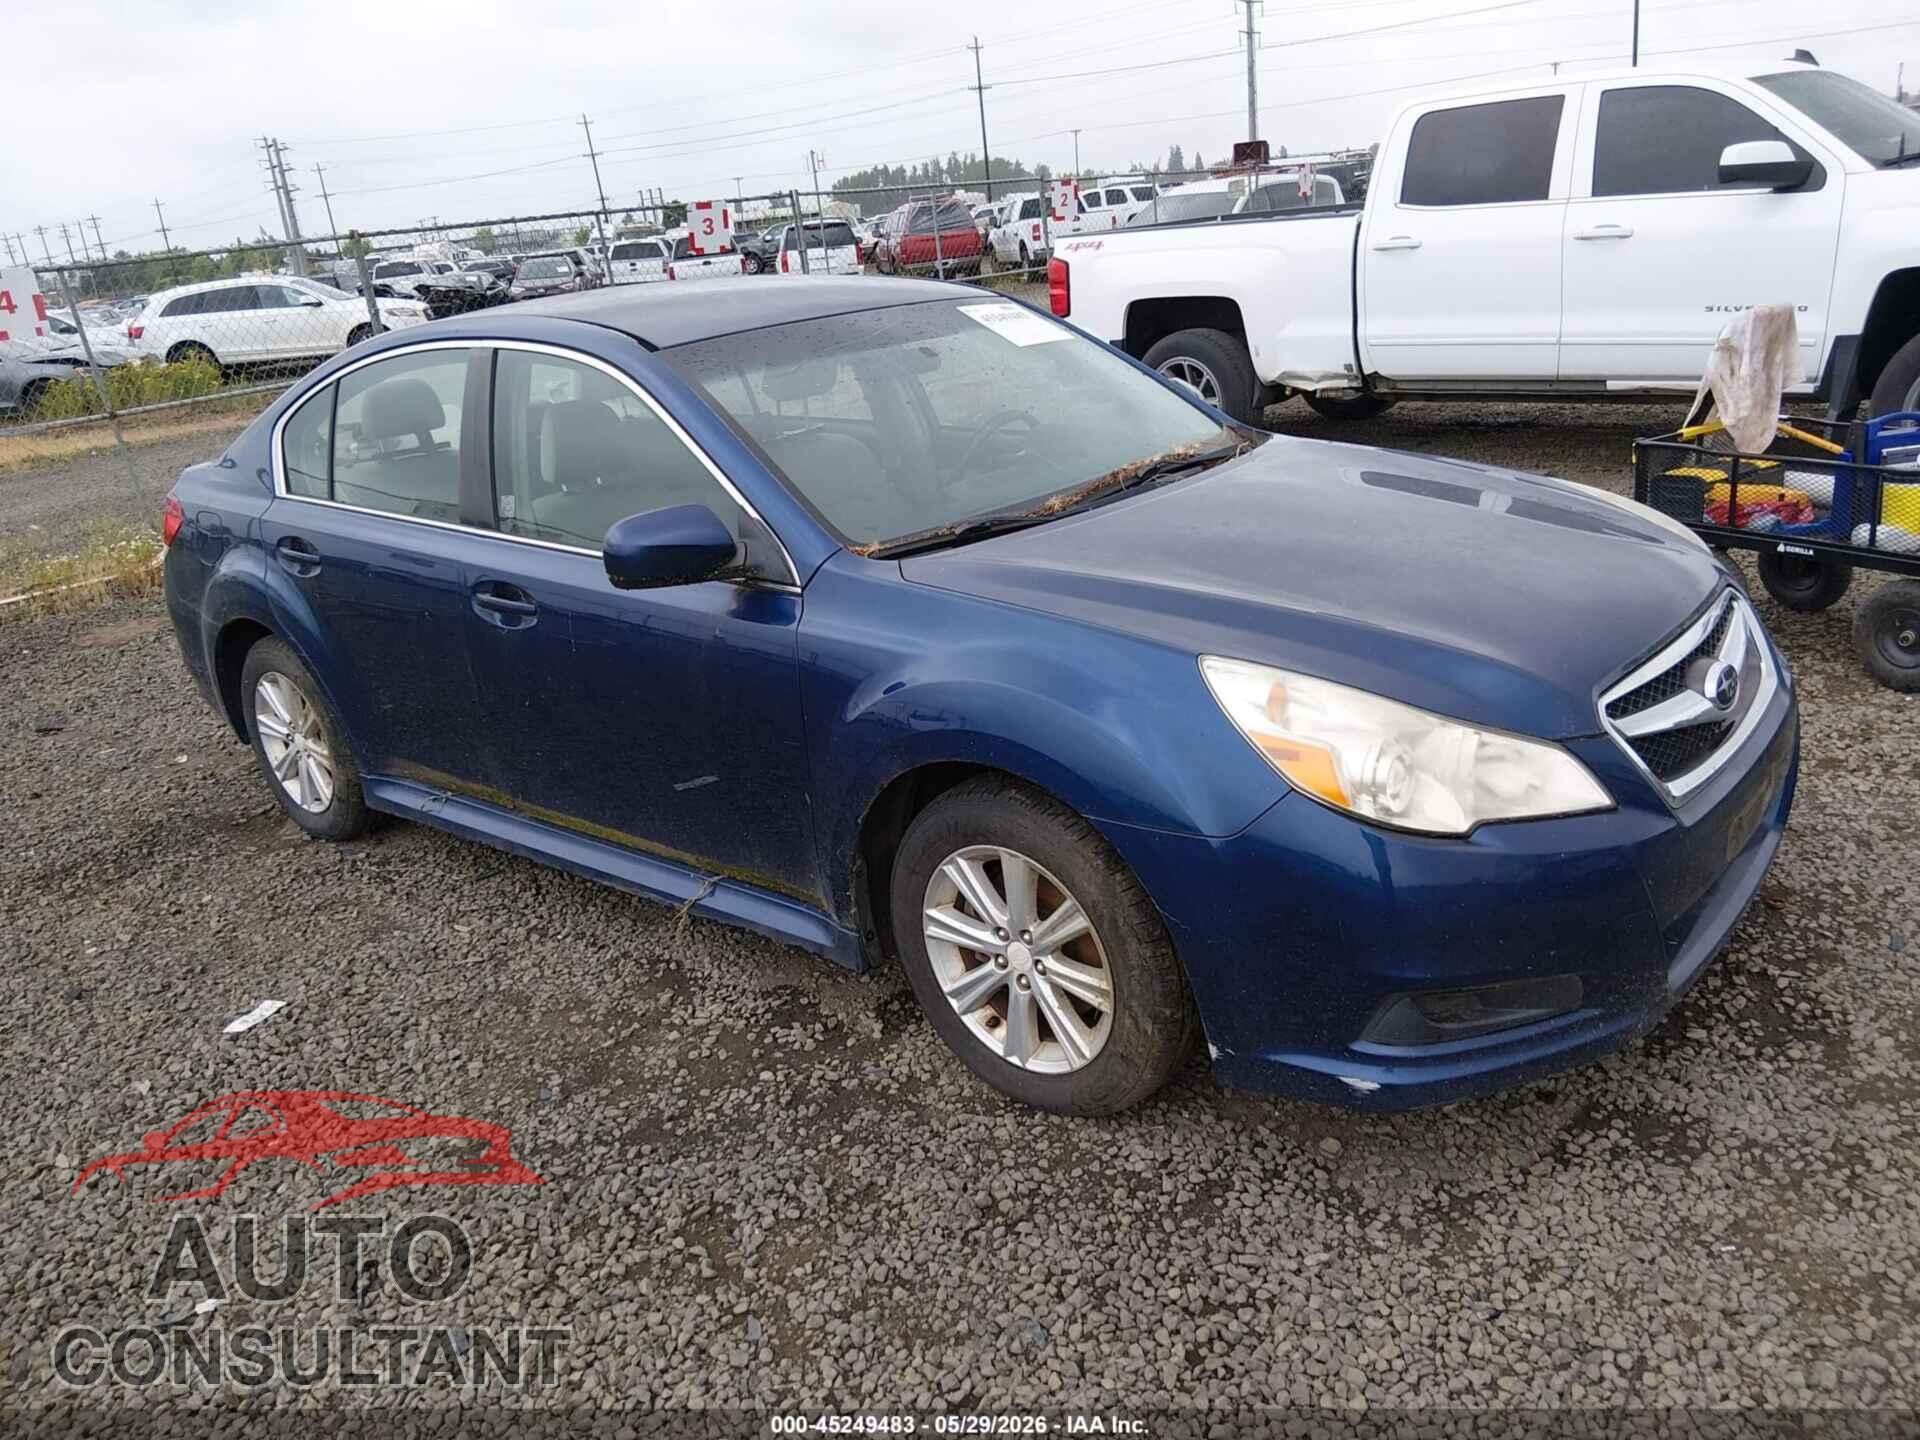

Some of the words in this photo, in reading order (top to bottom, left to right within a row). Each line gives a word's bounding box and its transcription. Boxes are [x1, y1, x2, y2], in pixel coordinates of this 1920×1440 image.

[1060, 193, 1068, 207] 2
[702, 217, 714, 235] 3
[0, 290, 18, 314] 4
